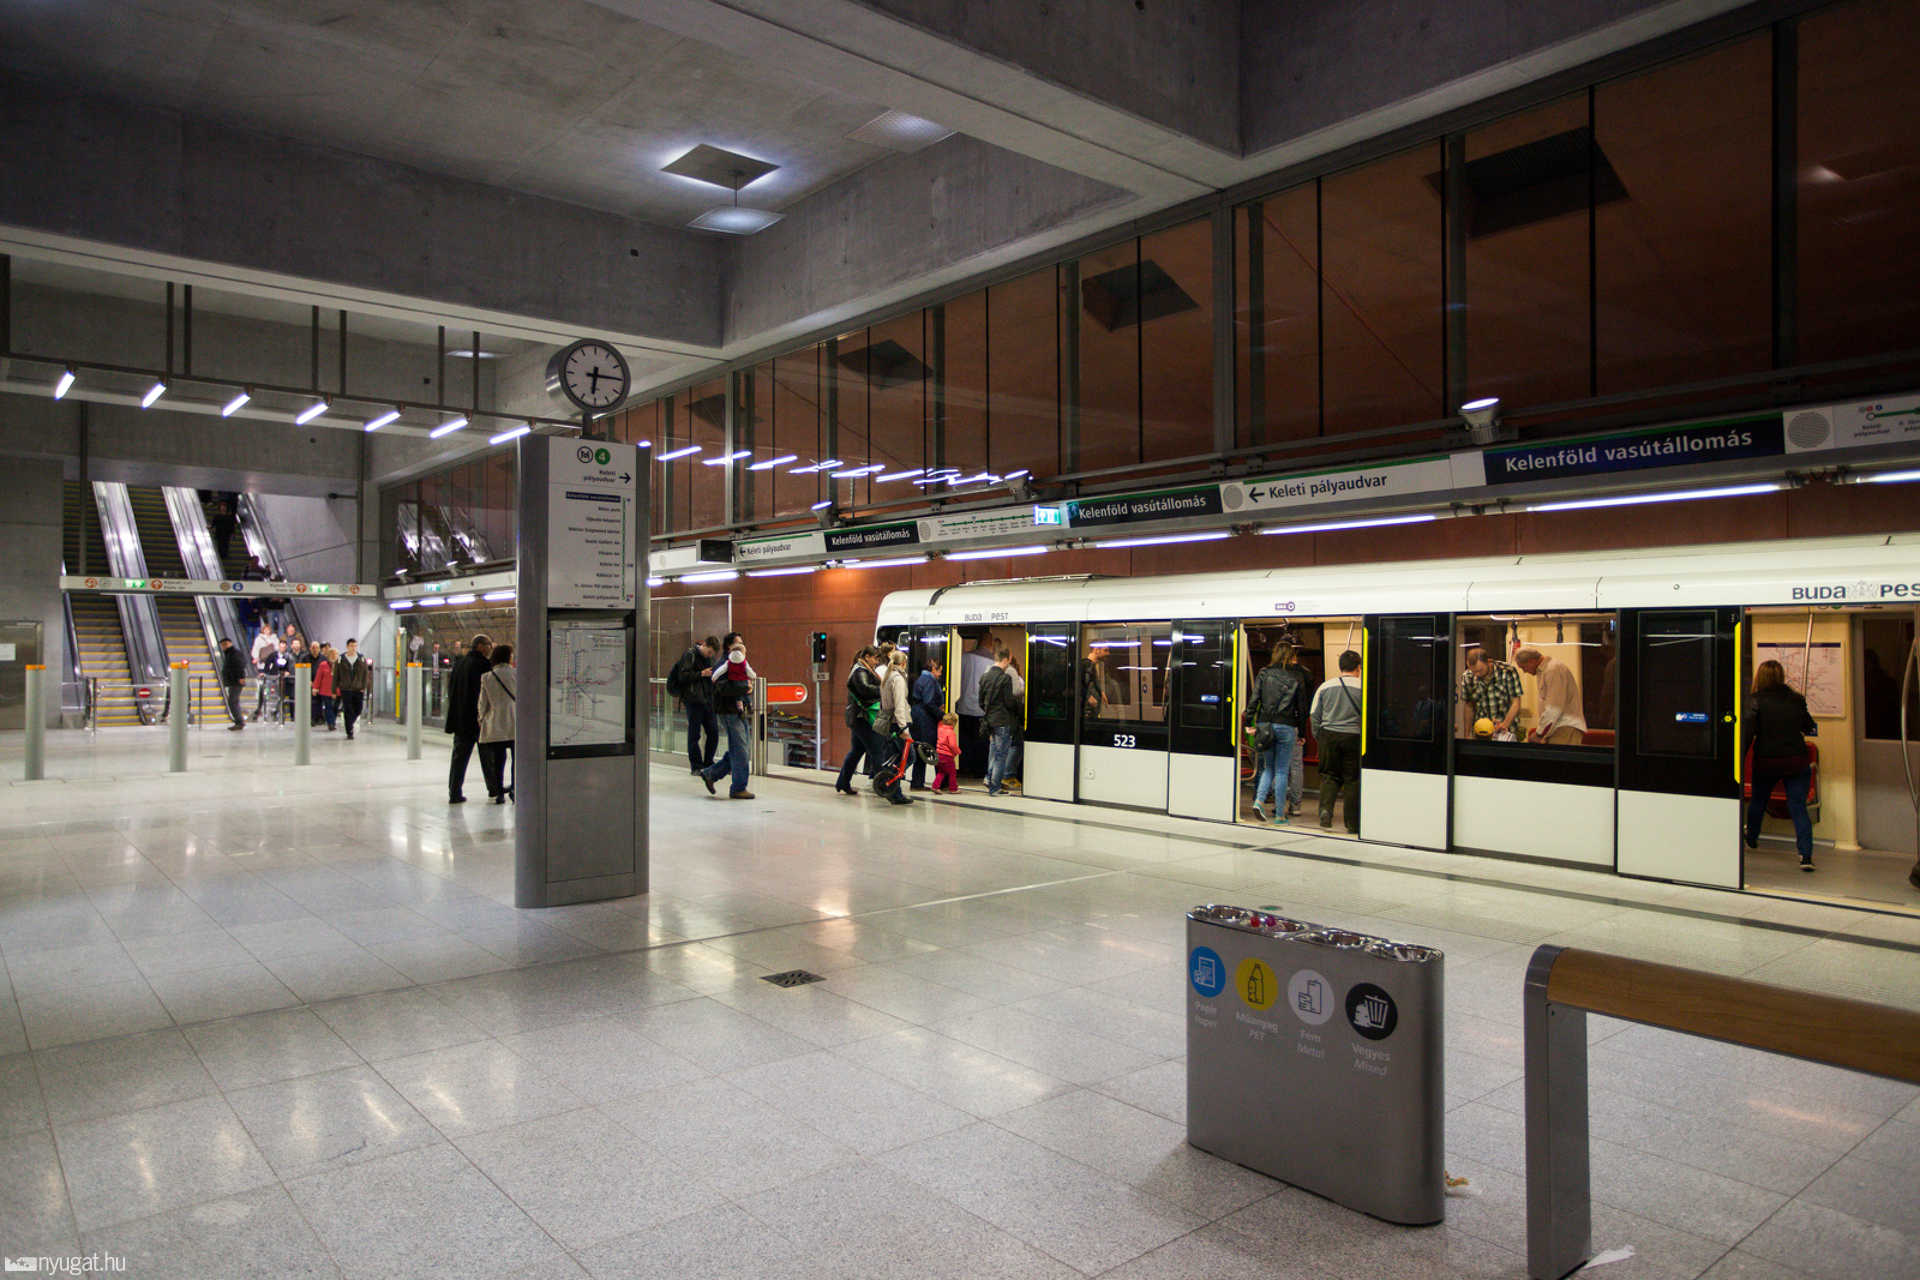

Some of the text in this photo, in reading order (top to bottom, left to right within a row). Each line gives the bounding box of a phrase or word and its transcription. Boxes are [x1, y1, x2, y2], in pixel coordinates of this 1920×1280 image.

[1505, 429, 1753, 472] Kelenföld vasútállomás
[1269, 474, 1387, 499] Keleti pályaudvar
[1079, 494, 1207, 519] Kelenföld vasútállomás
[831, 528, 910, 546] Kelenföld vasútállomás
[1113, 733, 1136, 748] 523
